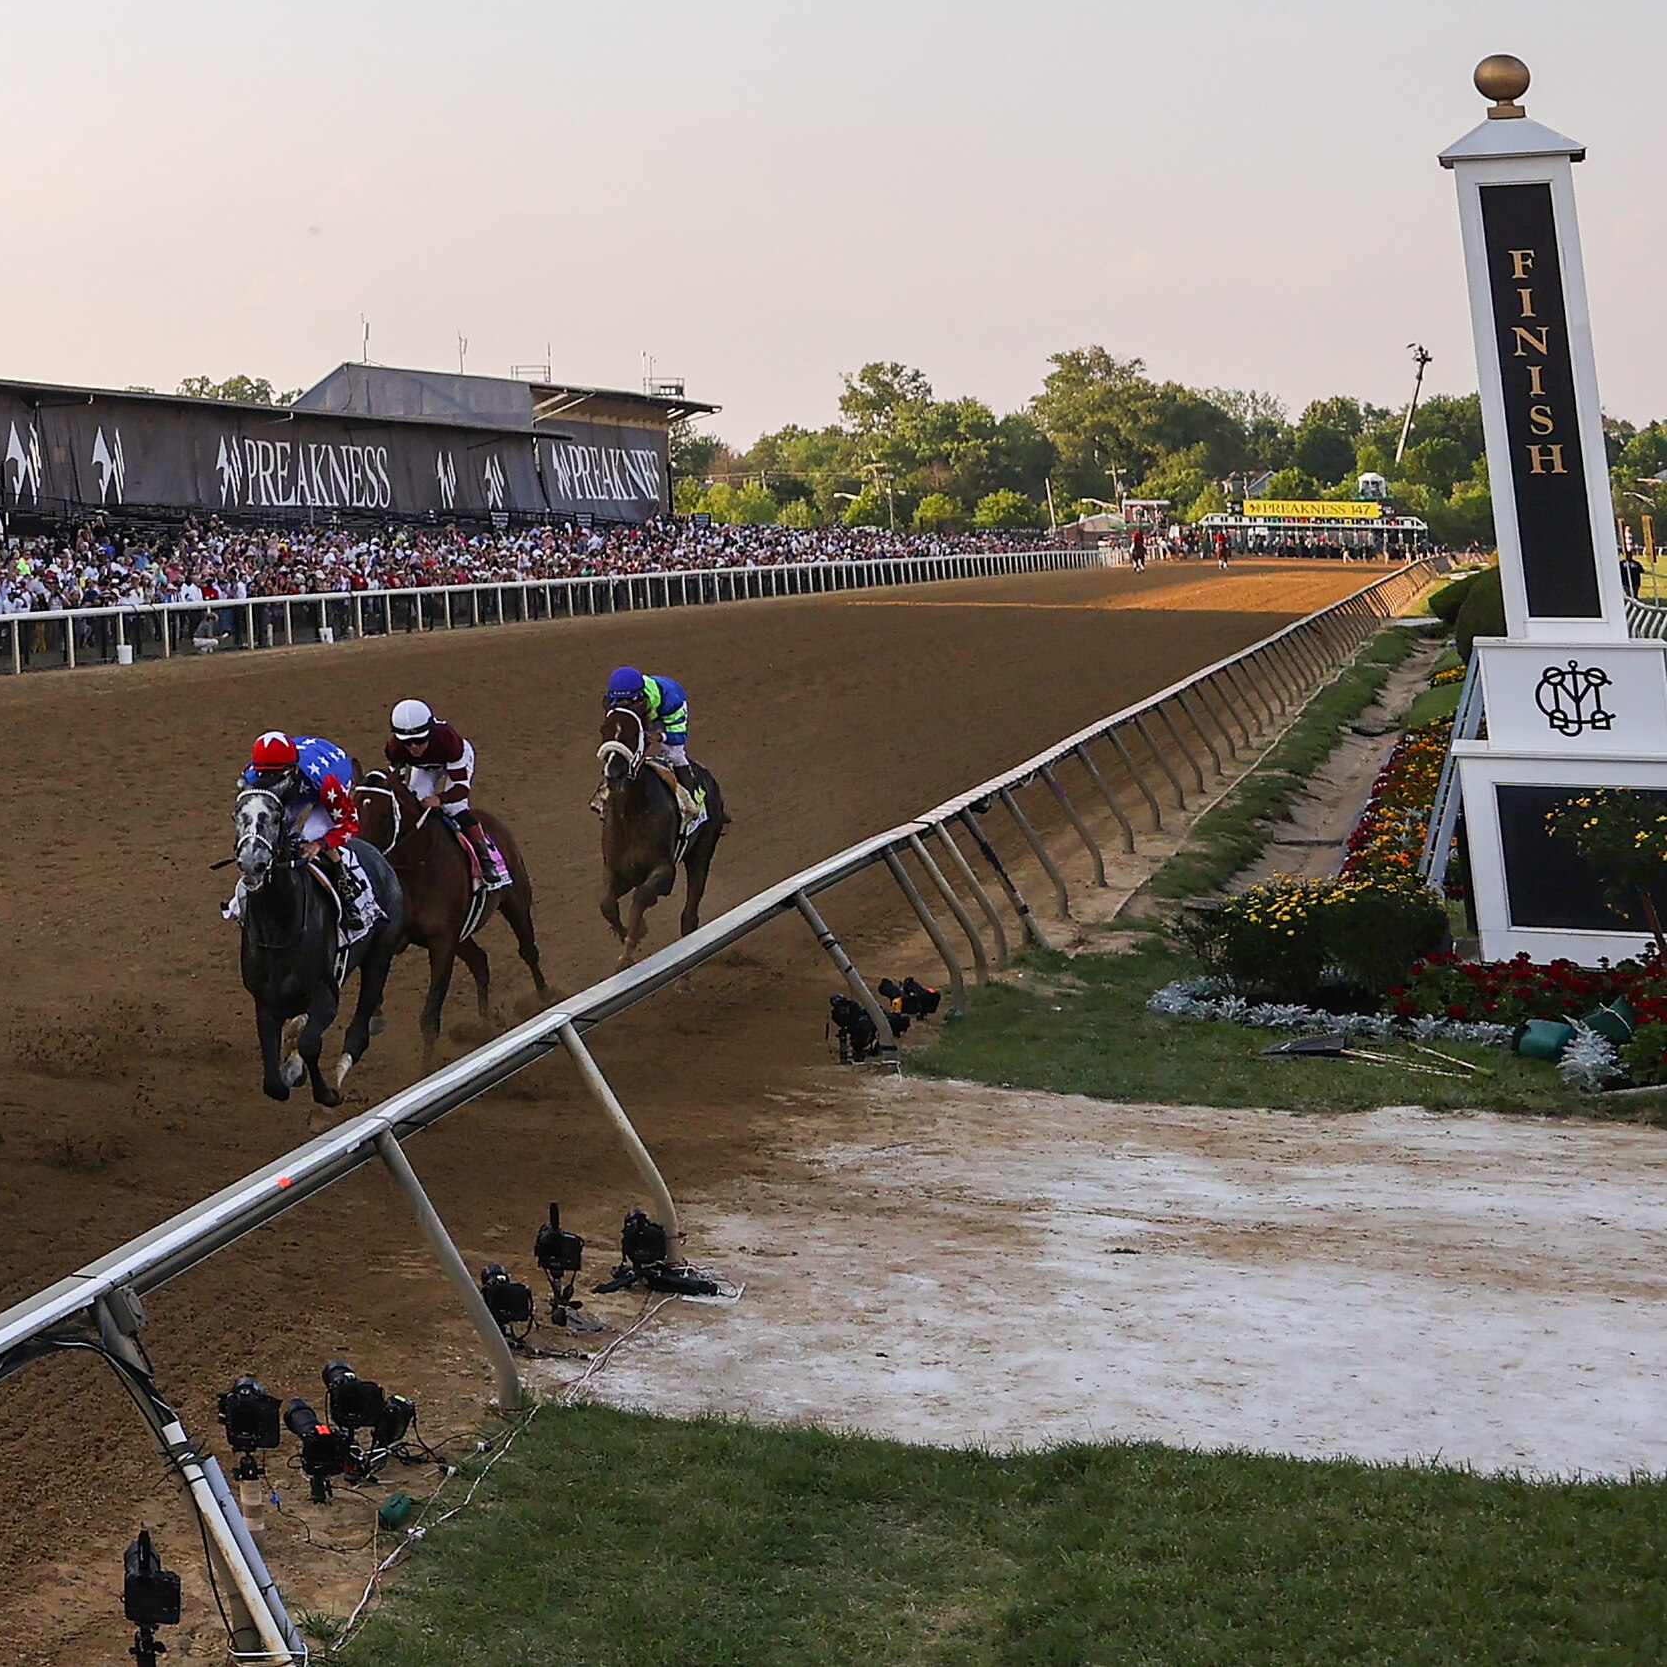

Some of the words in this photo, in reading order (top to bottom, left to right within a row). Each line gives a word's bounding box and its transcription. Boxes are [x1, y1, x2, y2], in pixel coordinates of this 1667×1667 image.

[1508, 249, 1567, 474] FINISH
[244, 439, 391, 508] PREAKNESS
[1263, 501, 1346, 515] PREAKNESS
[1351, 504, 1371, 515] 147
